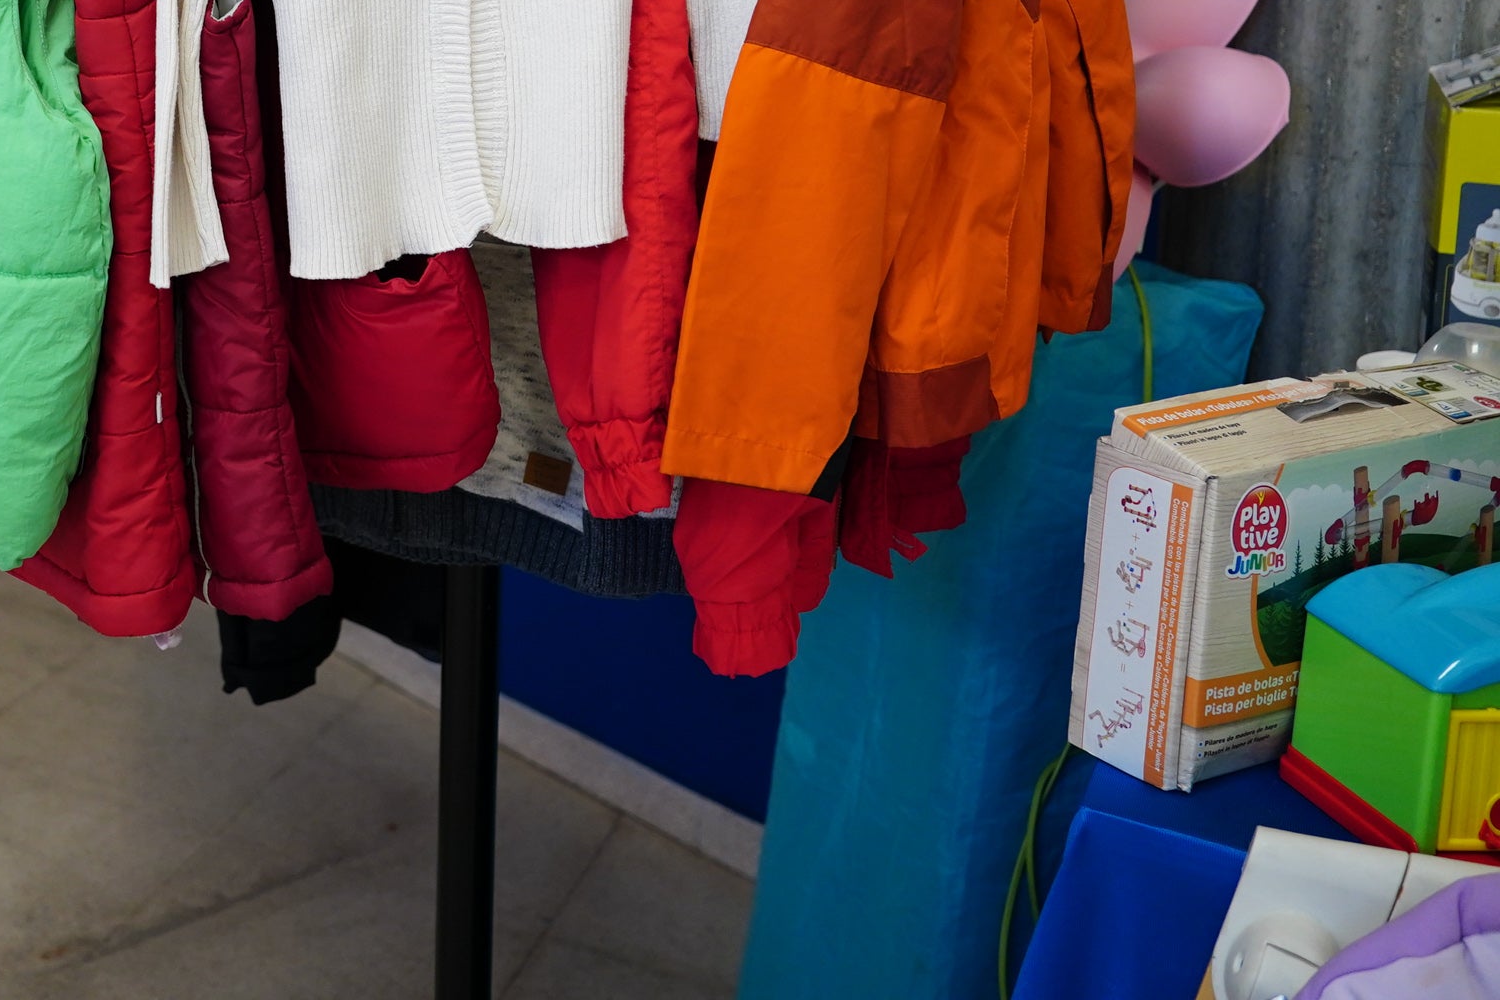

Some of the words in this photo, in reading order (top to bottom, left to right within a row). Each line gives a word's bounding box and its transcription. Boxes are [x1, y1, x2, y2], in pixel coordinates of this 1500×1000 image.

[1136, 415, 1164, 427] Pista
[1240, 526, 1279, 549] tive
[1228, 551, 1284, 574] JUNIOR
[1205, 687, 1235, 701] Pista
[1237, 682, 1252, 695] de
[1254, 675, 1284, 691] bolas
[1204, 703, 1234, 717] Pista
[1235, 698, 1255, 713] per
[1256, 689, 1287, 706] biglie
